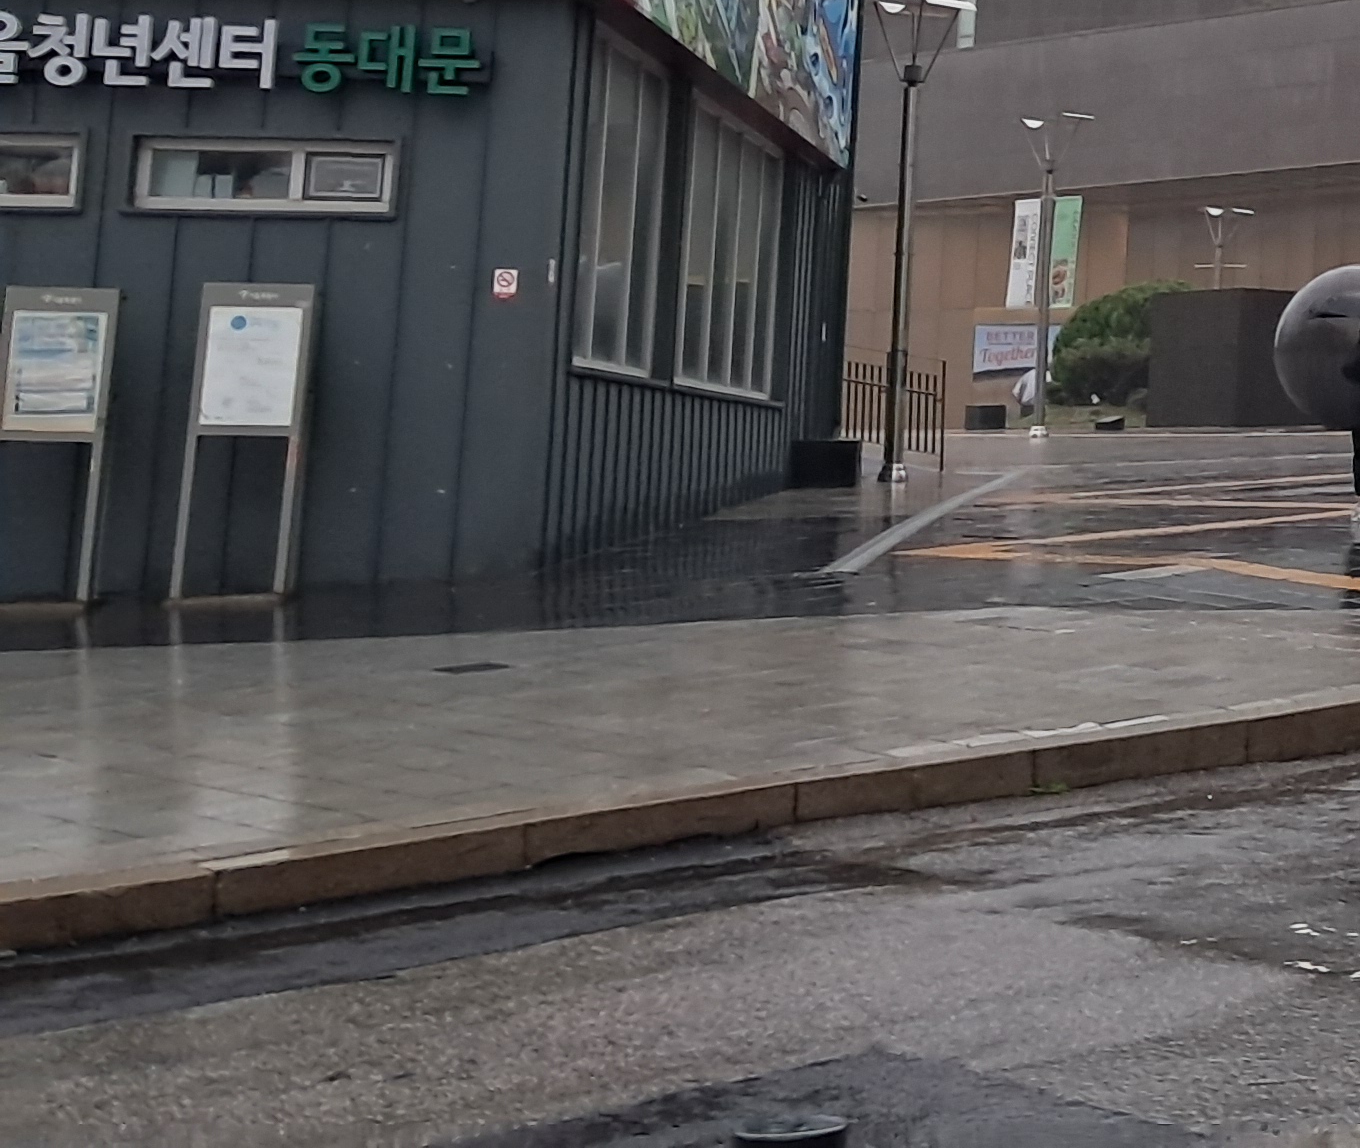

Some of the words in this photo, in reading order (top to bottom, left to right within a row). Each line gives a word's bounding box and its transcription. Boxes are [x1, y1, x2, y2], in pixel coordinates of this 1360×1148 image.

[292, 20, 482, 96] 동대문
[986, 331, 1035, 341] BETTER
[980, 348, 1037, 366] Together
